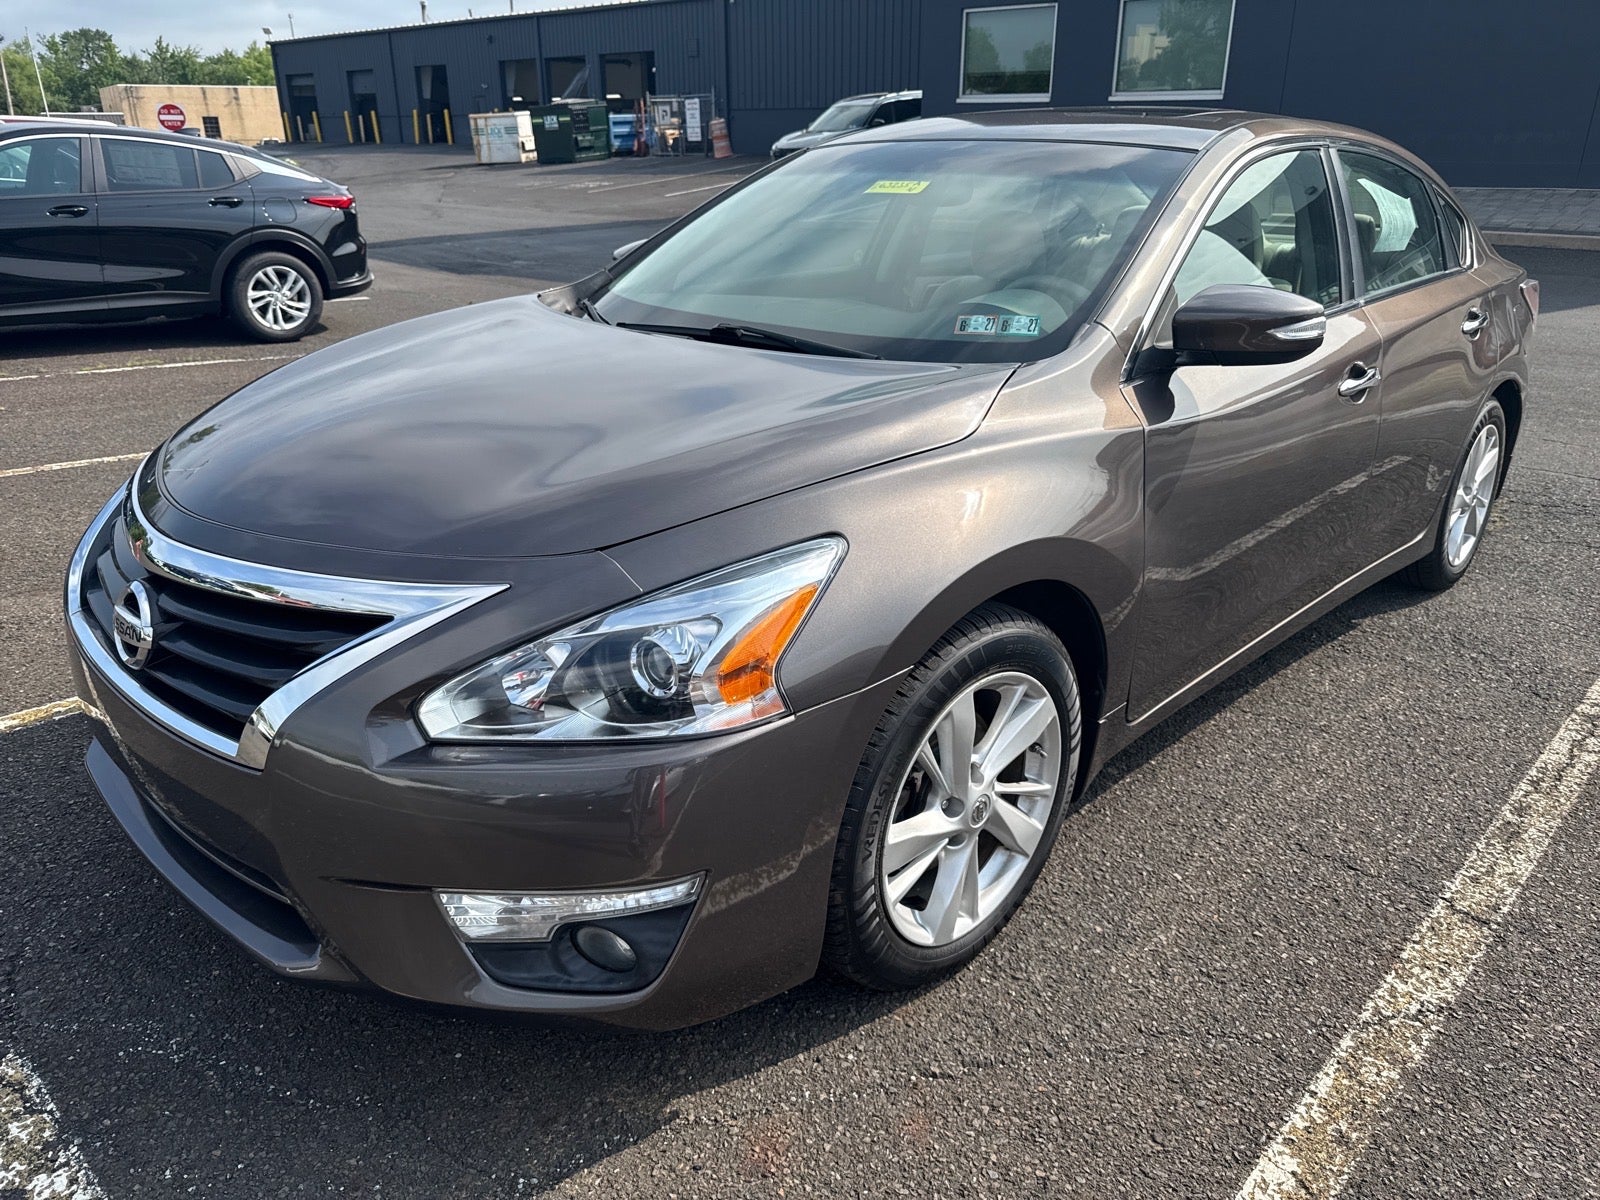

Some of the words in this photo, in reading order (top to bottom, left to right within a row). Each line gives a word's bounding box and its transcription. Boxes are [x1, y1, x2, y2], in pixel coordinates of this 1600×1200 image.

[960, 320, 966, 332] 6
[984, 318, 996, 331] 27
[1001, 319, 1008, 332] 6
[1027, 318, 1039, 332] 27
[115, 617, 142, 642] SSAN
